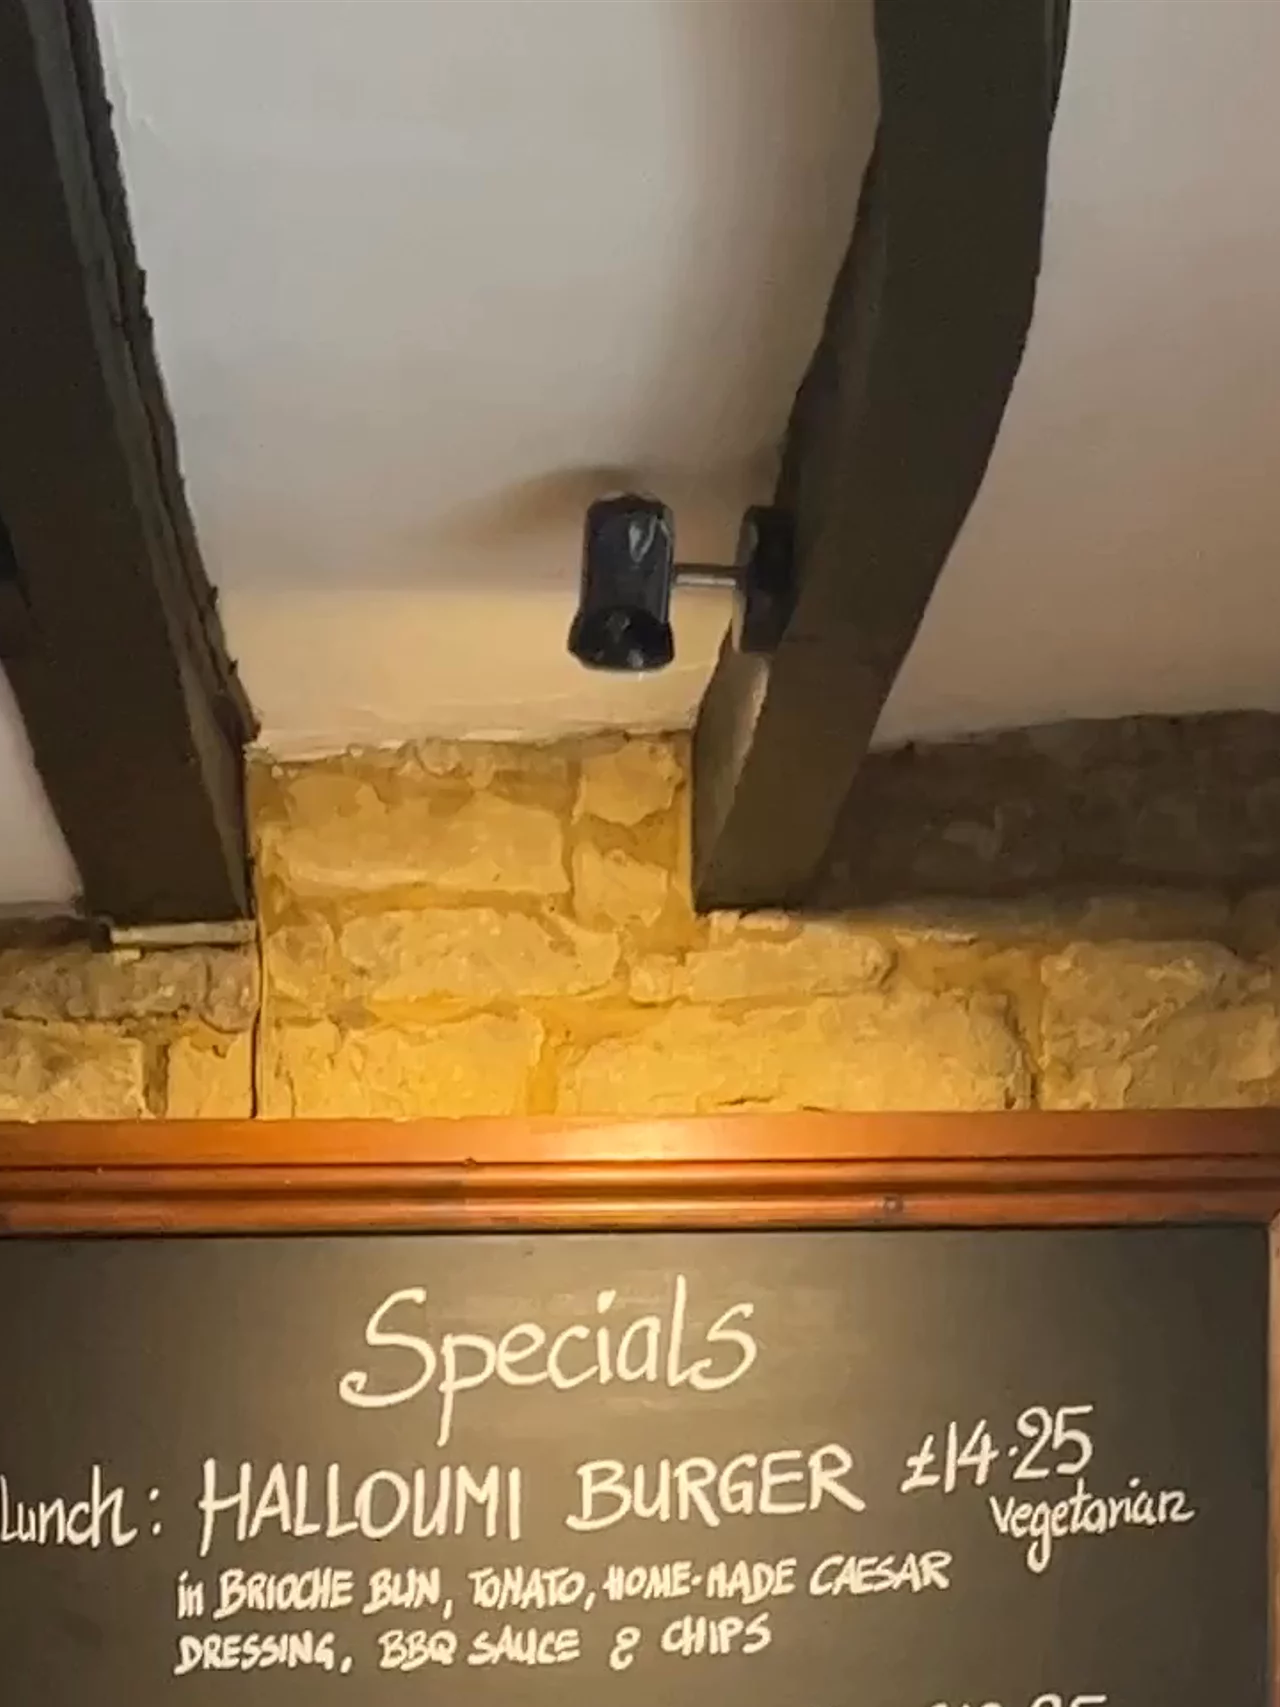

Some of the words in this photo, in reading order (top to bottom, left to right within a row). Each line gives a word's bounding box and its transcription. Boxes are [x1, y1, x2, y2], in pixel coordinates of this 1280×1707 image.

[340, 1275, 757, 1446] Specials
[199, 1459, 521, 1556] HALLOUMI
[566, 1444, 865, 1531] BURGER
[177, 1570, 203, 1618] in
[213, 1567, 354, 1618] BRIOCHE
[362, 1567, 453, 1619] BUN,
[468, 1565, 597, 1613] TOMATO,
[809, 1551, 952, 1596] CAESAR
[174, 1629, 353, 1674] DRESSING,
[378, 1629, 458, 1671] BBQ
[470, 1623, 580, 1666] SAUCE
[661, 1612, 772, 1656] CHIPS
